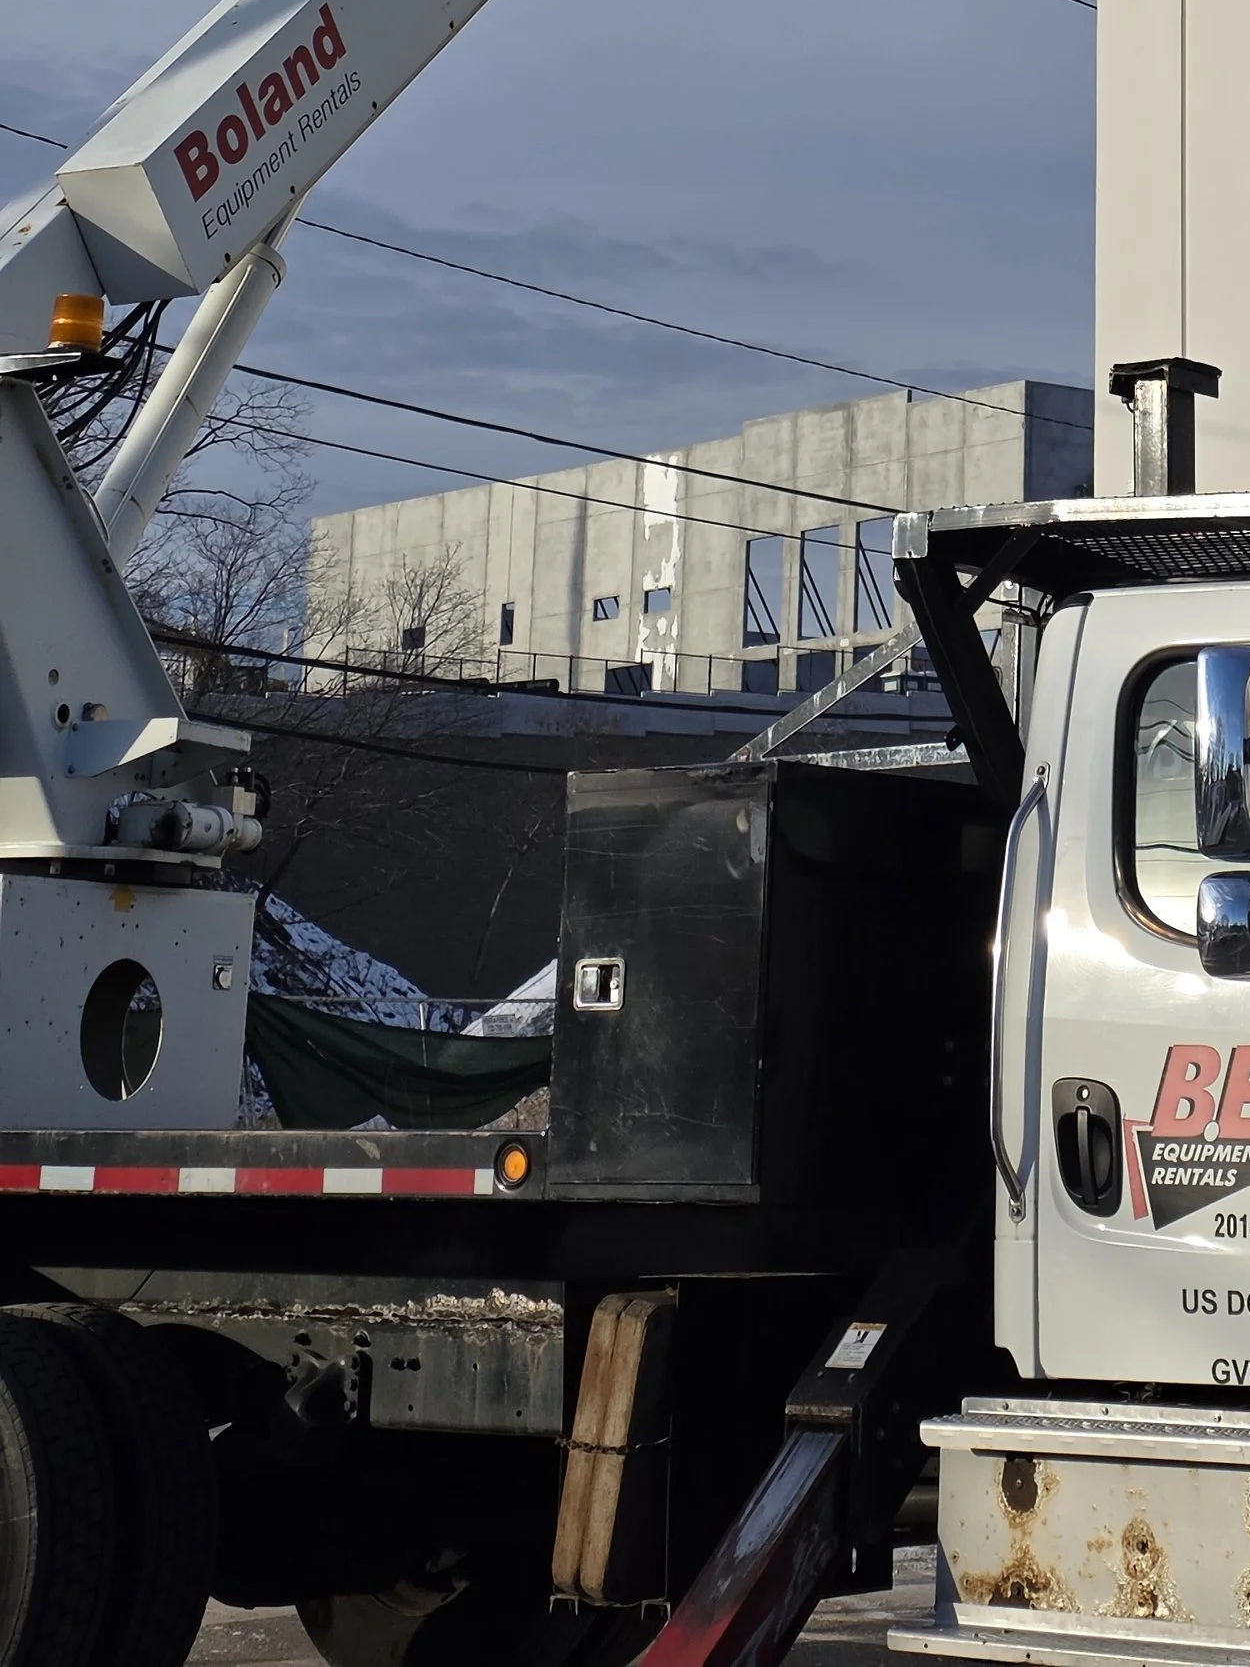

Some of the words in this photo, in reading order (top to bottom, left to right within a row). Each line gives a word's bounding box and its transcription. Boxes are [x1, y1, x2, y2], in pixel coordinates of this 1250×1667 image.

[173, 2, 347, 203] Boland
[202, 131, 298, 239] Equipment
[297, 71, 361, 142] Rentals
[1151, 1167, 1238, 1187] RENTALS
[1182, 1289, 1218, 1315] US
